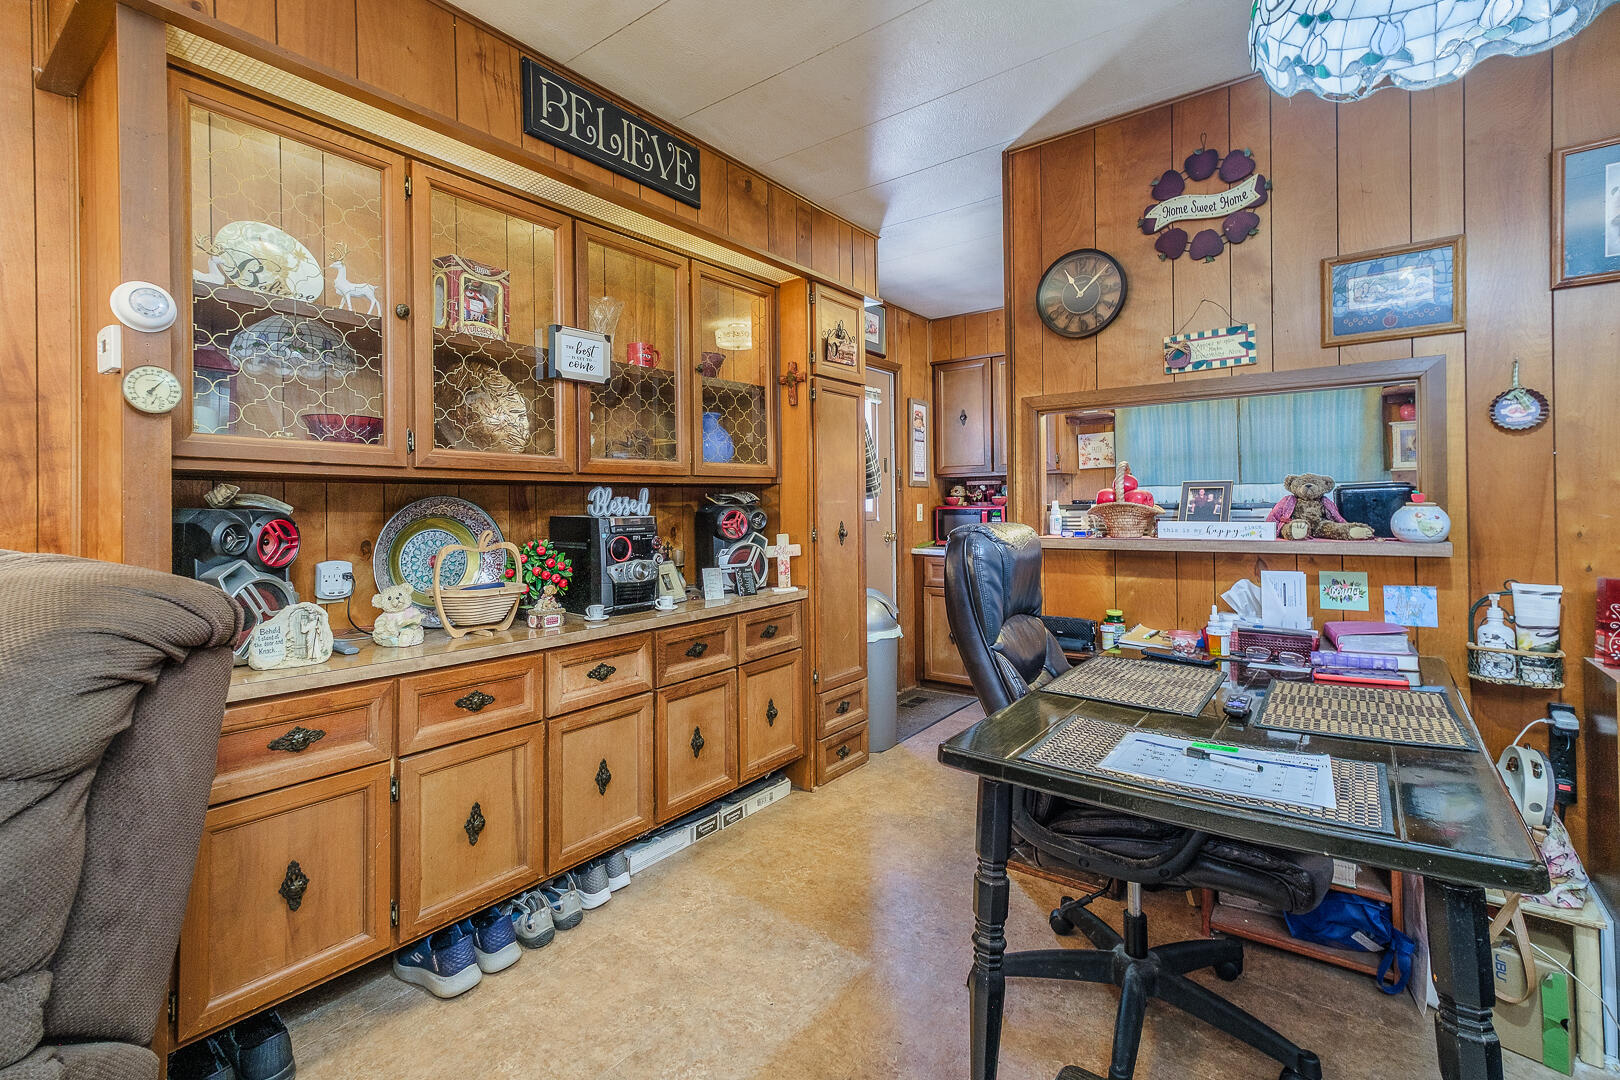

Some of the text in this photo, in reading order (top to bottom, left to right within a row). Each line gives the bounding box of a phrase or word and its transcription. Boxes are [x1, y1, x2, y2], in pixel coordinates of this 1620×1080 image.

[539, 75, 696, 192] BELIEVE
[1162, 190, 1249, 219] Home Sweet Home
[576, 341, 600, 358] best
[568, 361, 596, 373] come
[587, 485, 651, 518] Blessed
[1193, 528, 1203, 536] my
[1206, 524, 1240, 538] happy
[1329, 584, 1361, 597] Beauty
[259, 626, 281, 636] Behold
